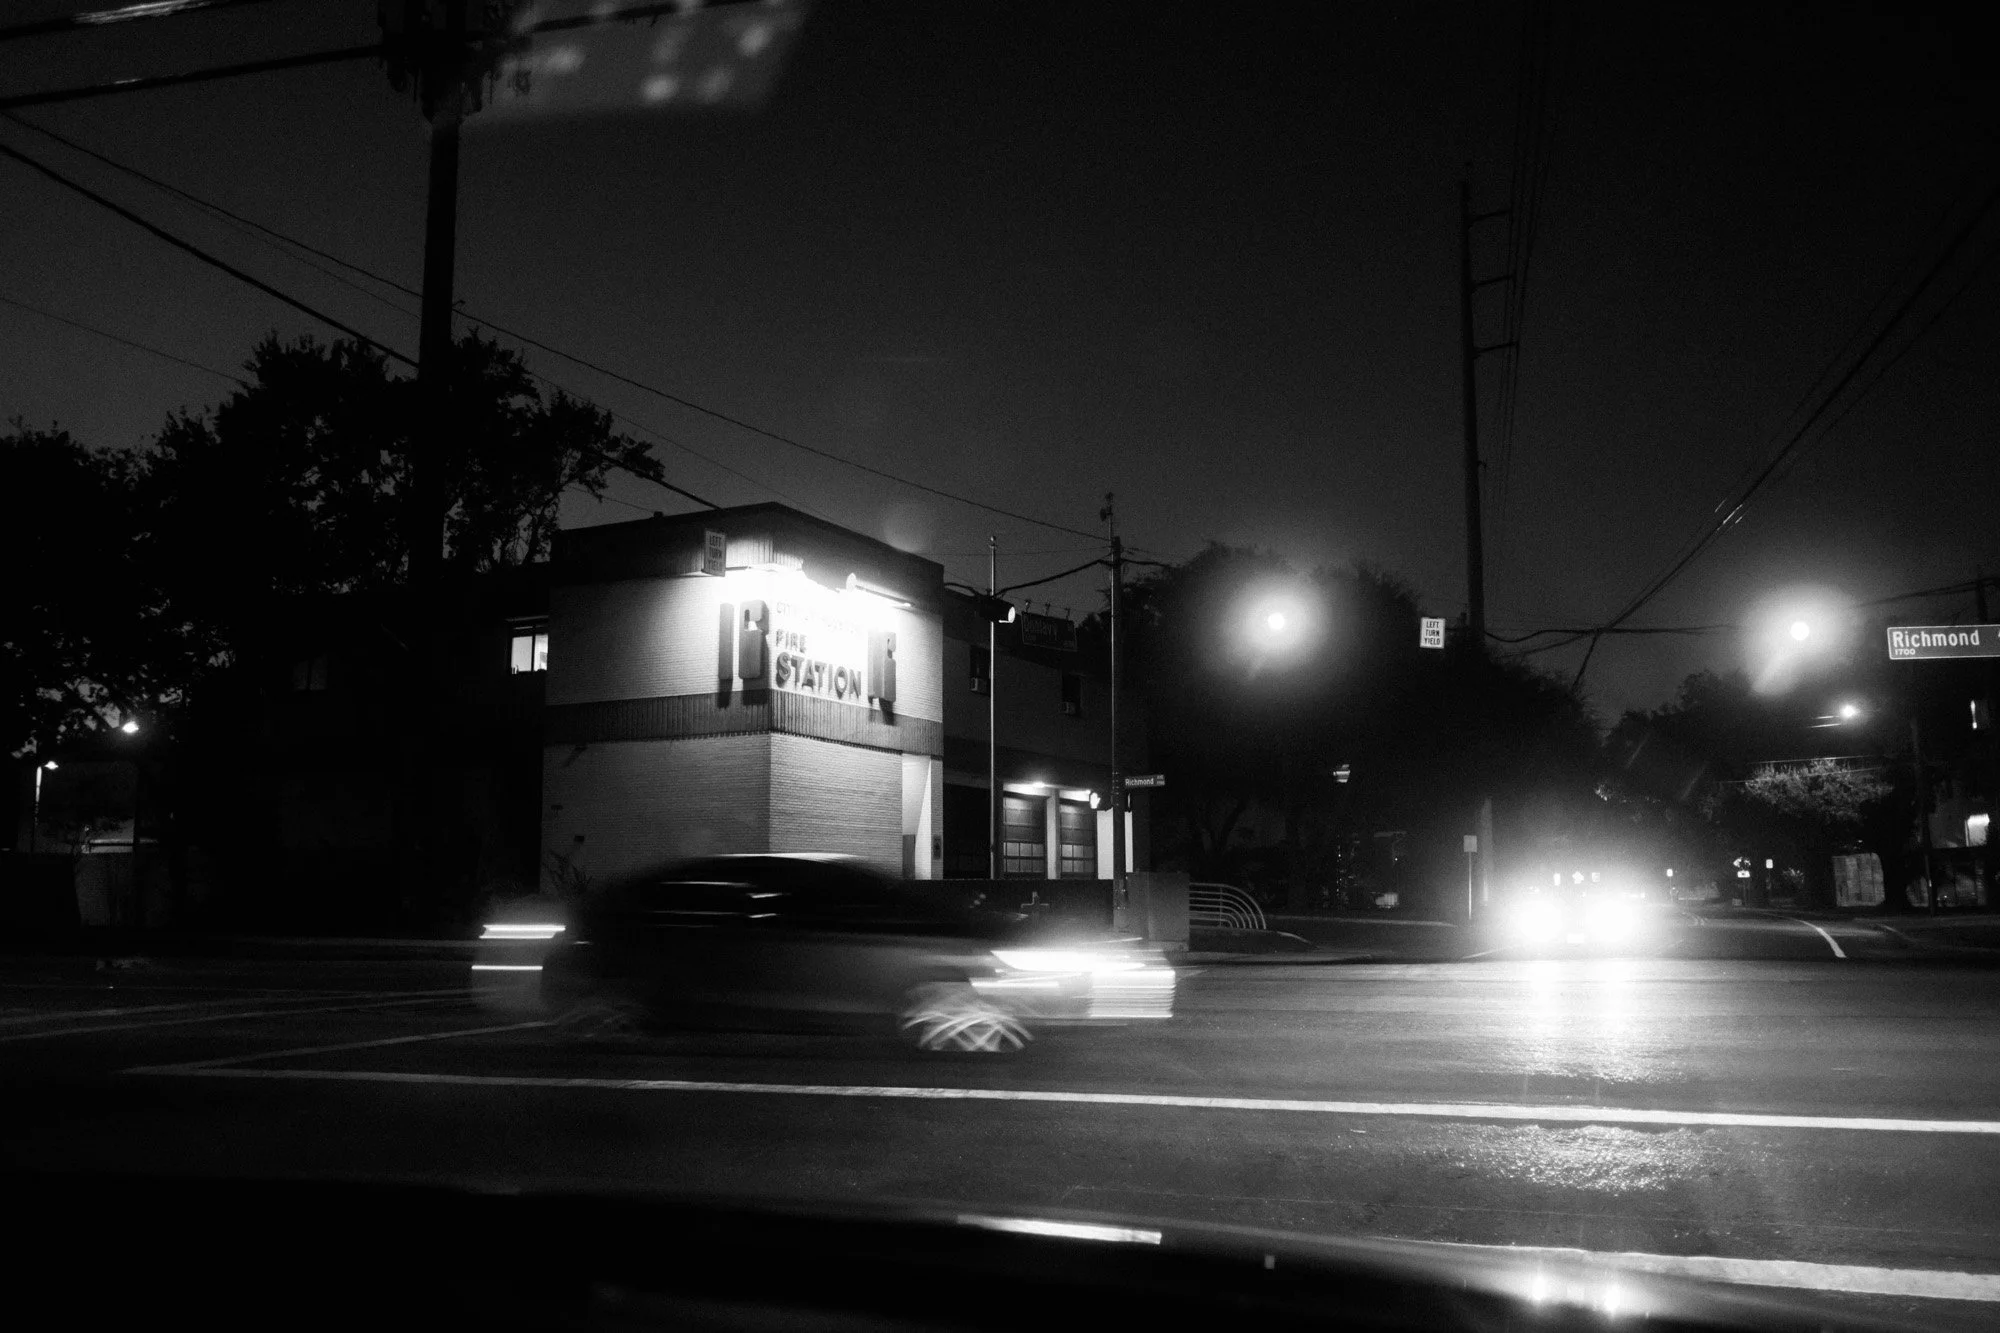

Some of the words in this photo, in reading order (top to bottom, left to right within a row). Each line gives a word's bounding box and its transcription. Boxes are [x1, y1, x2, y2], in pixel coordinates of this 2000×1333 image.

[709, 535, 722, 548] LEFT
[1425, 629, 1440, 637] TURN
[775, 629, 807, 653] FIRE
[1424, 637, 1440, 645] YIELD
[1892, 630, 1980, 648] Richmond
[1894, 648, 1916, 656] 1700
[775, 652, 862, 700] STATION
[1125, 777, 1154, 786] Richmond
